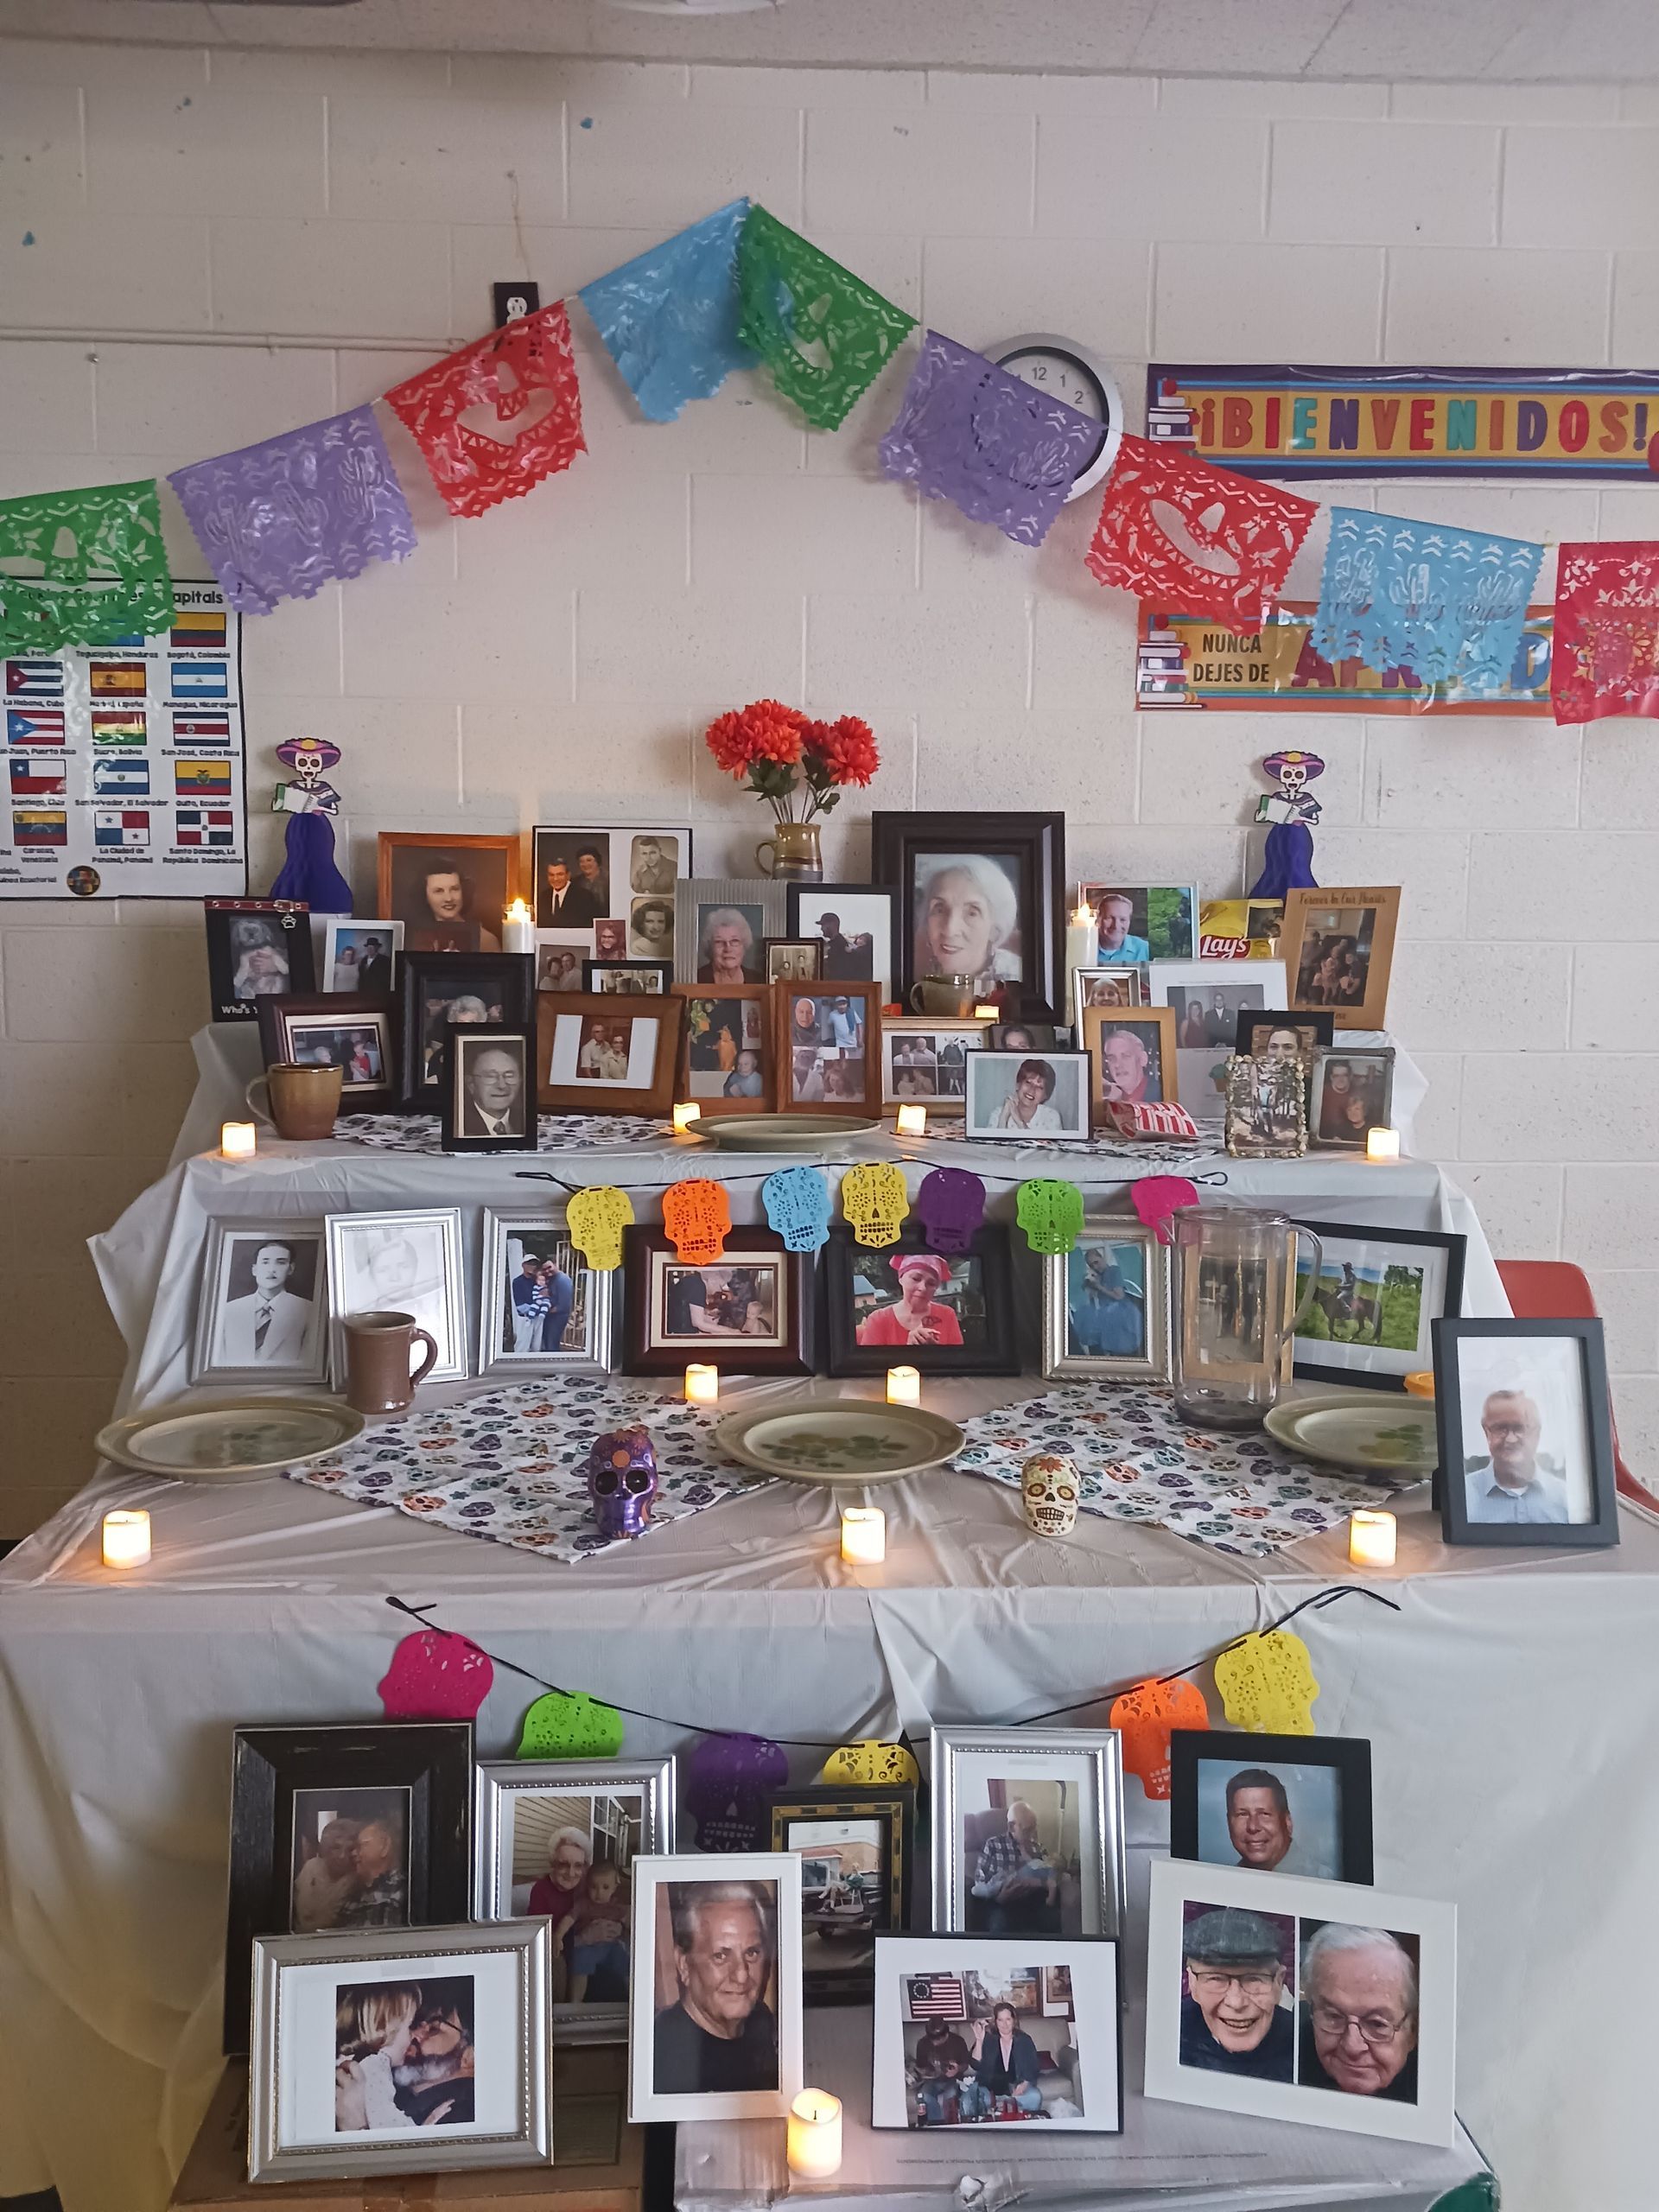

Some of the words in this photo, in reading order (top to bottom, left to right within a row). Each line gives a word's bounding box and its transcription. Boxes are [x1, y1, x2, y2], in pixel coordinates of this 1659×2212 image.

[1032, 366, 1047, 381] 12
[1059, 374, 1066, 387] 1
[1074, 391, 1084, 404] 2
[1200, 397, 1649, 453] ¡BIENVENIDOS!
[172, 591, 224, 606] apitals
[1203, 633, 1262, 653] NUNCA
[1193, 663, 1243, 683] DEJES
[1249, 663, 1269, 683] DE
[1201, 935, 1247, 959] Lay's
